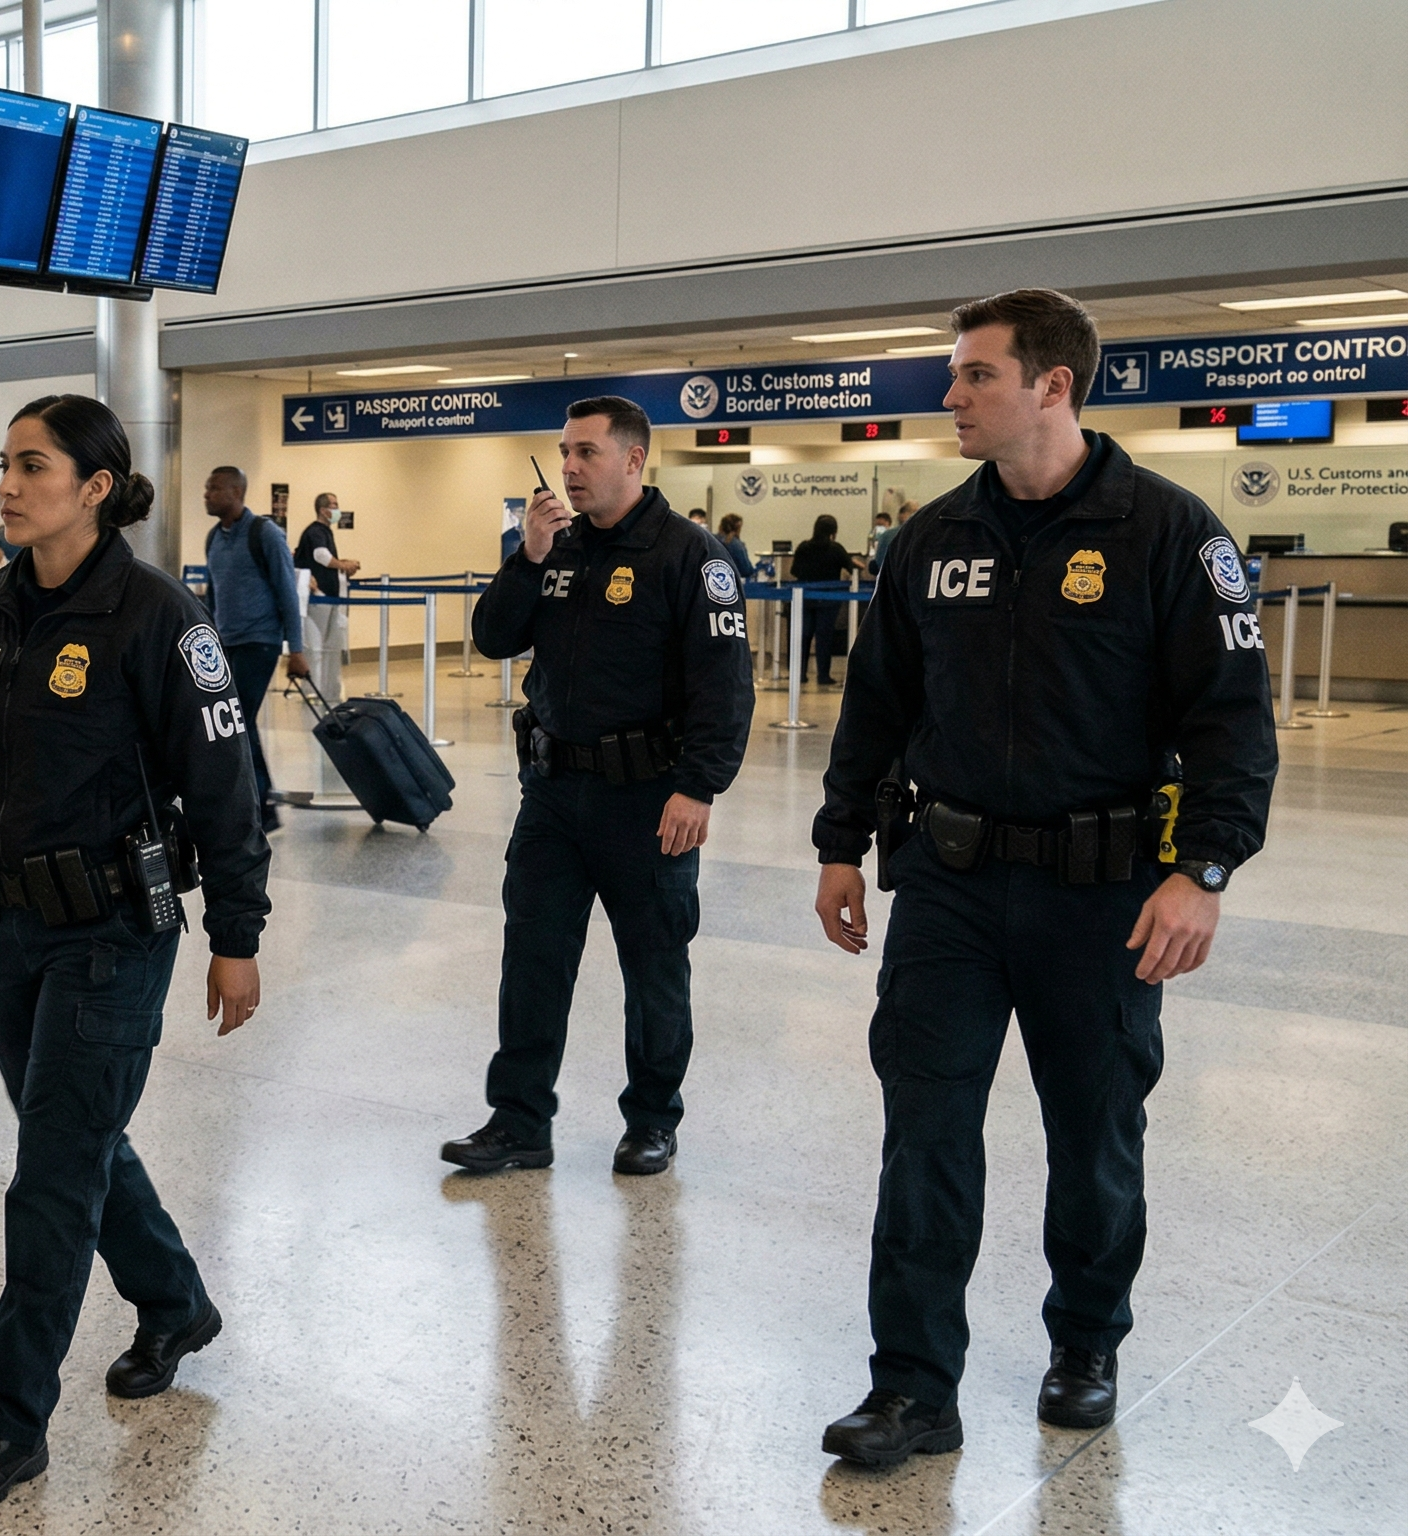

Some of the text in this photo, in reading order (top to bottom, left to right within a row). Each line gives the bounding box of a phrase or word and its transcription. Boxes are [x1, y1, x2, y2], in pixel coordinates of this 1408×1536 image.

[1160, 335, 1408, 370] PASSPORT CONTRO
[726, 367, 871, 393] U.S. Customs and
[1206, 369, 1282, 389] Passport
[1313, 363, 1367, 382] ontrol
[355, 392, 502, 415] PASSPORT CONTROL
[726, 391, 871, 413] Border Protection
[840, 472, 858, 482] and
[1288, 467, 1408, 480] U.S. Customs an
[773, 486, 807, 497] Border
[1288, 482, 1408, 496] Border Protectio
[542, 569, 574, 597] CE
[927, 558, 995, 599] ICE
[709, 610, 746, 638] ICE
[1218, 613, 1265, 651] ICE
[201, 697, 246, 742] ICE
